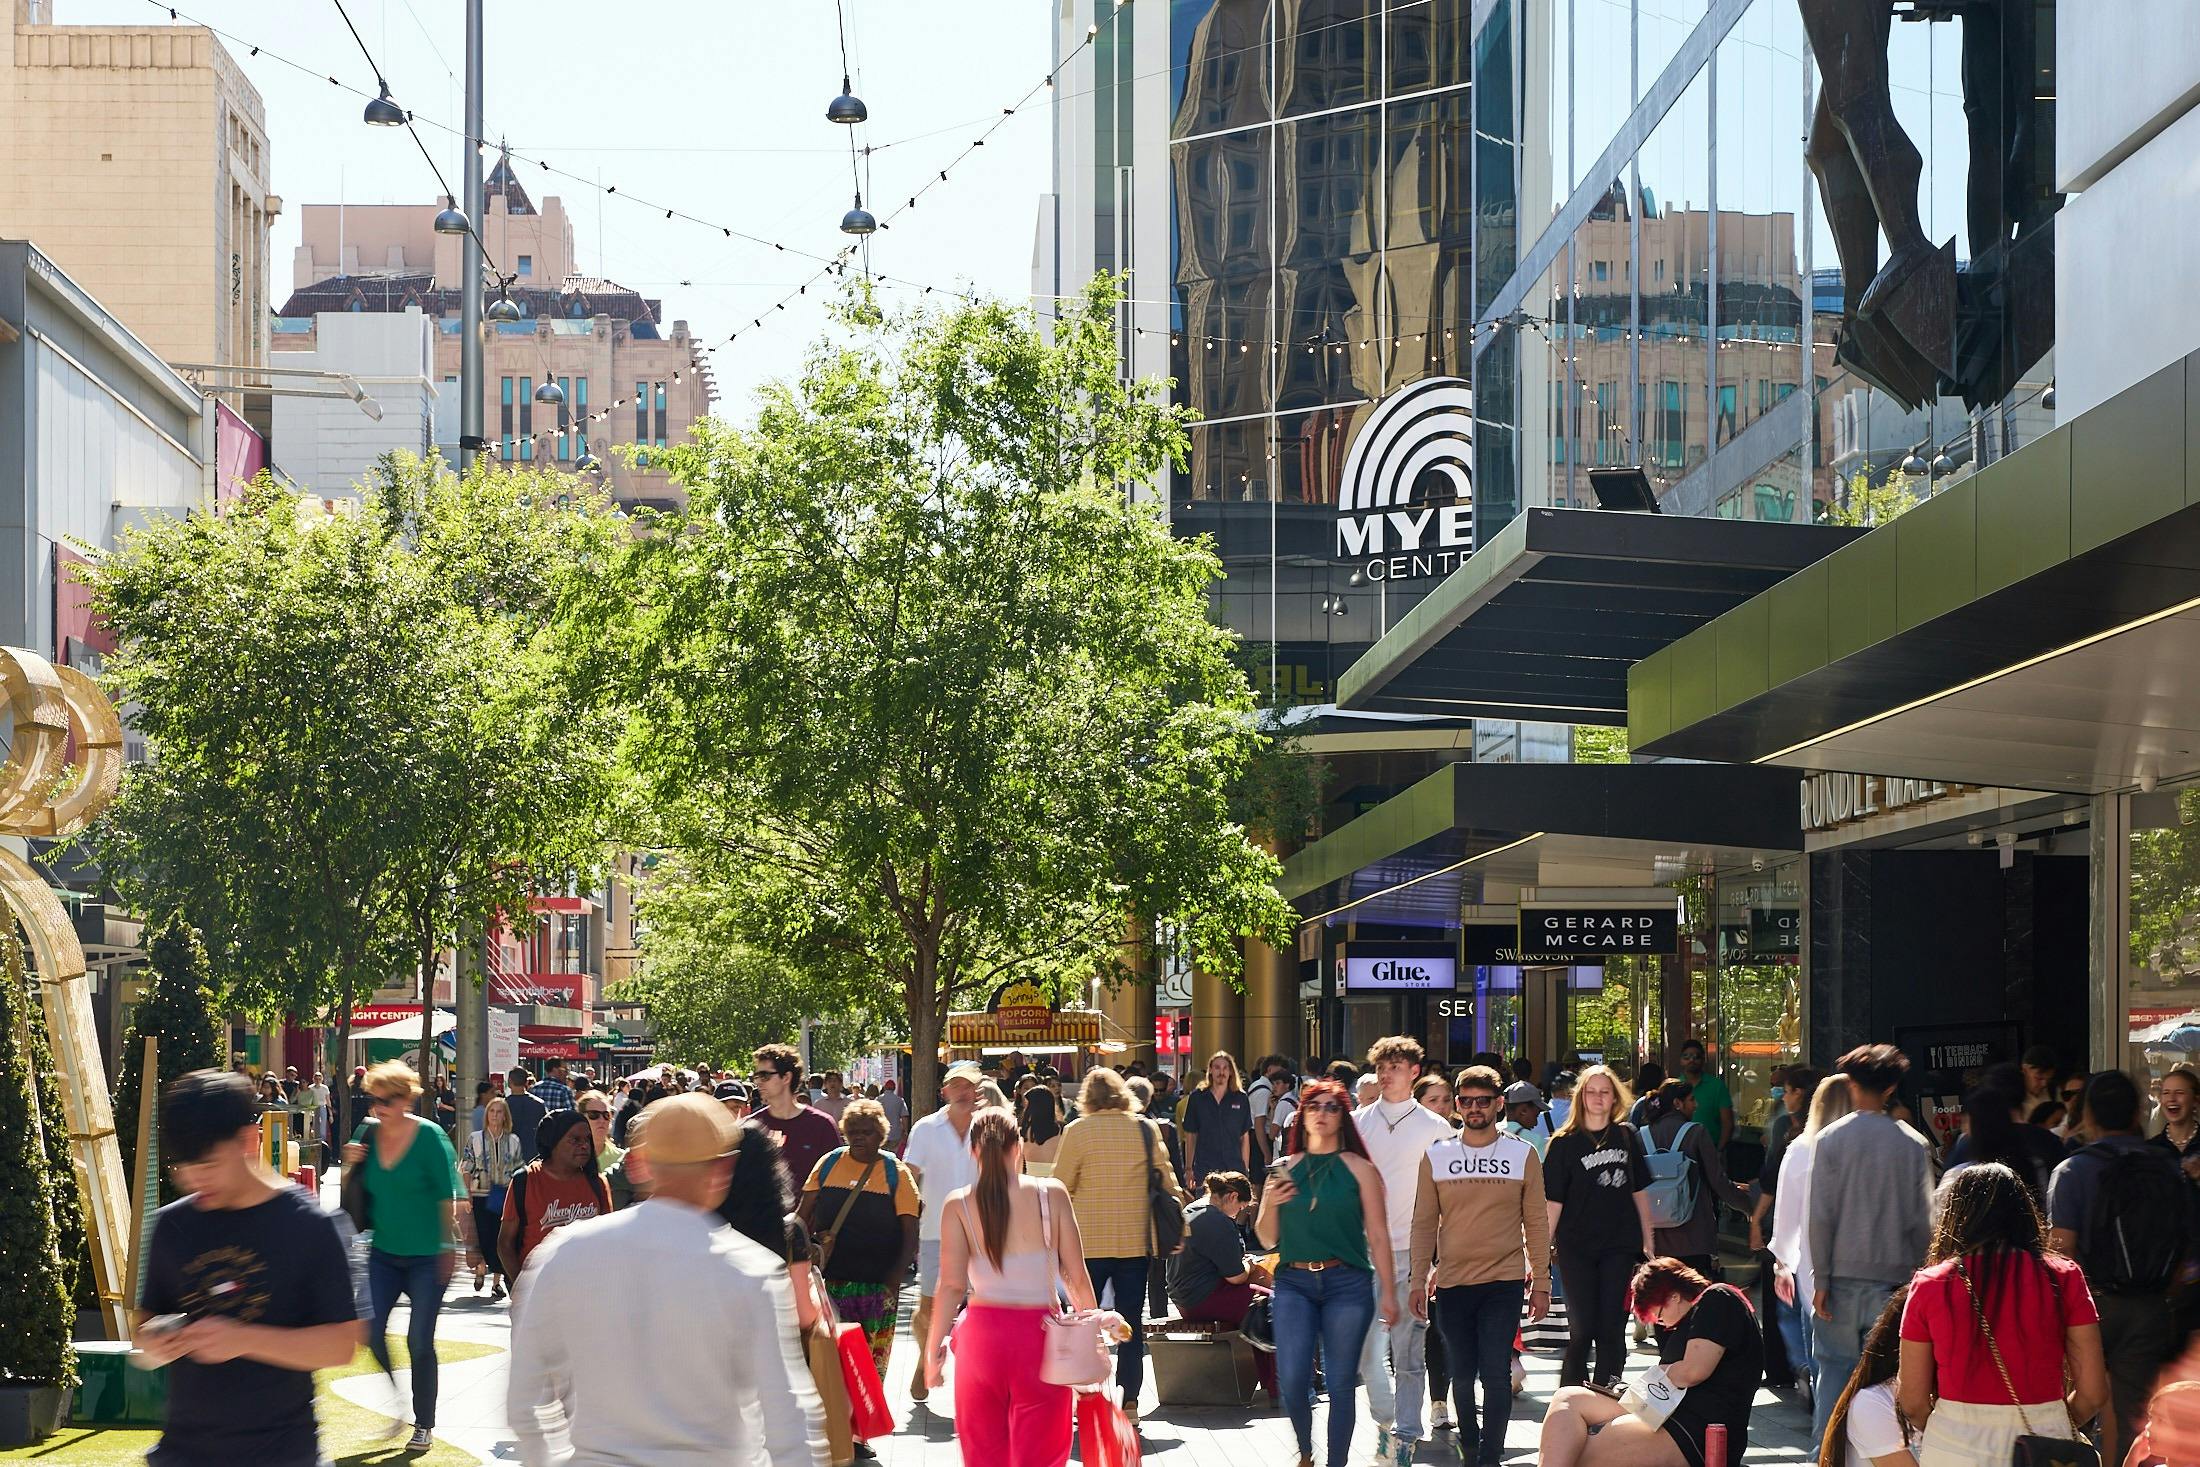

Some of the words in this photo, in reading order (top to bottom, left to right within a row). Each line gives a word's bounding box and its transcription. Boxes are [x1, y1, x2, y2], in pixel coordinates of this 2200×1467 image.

[1800, 772, 1879, 831] RUNDLE
[1544, 917, 1654, 929] GERARD
[1371, 960, 1431, 981] Glue.
[350, 1011, 379, 1020] IGHT
[1000, 1009, 1050, 1018] POPCORN
[1004, 1018, 1046, 1026] DELIGHTS
[1932, 1105, 1956, 1114] Food
[1449, 1158, 1511, 1175] GUESS
